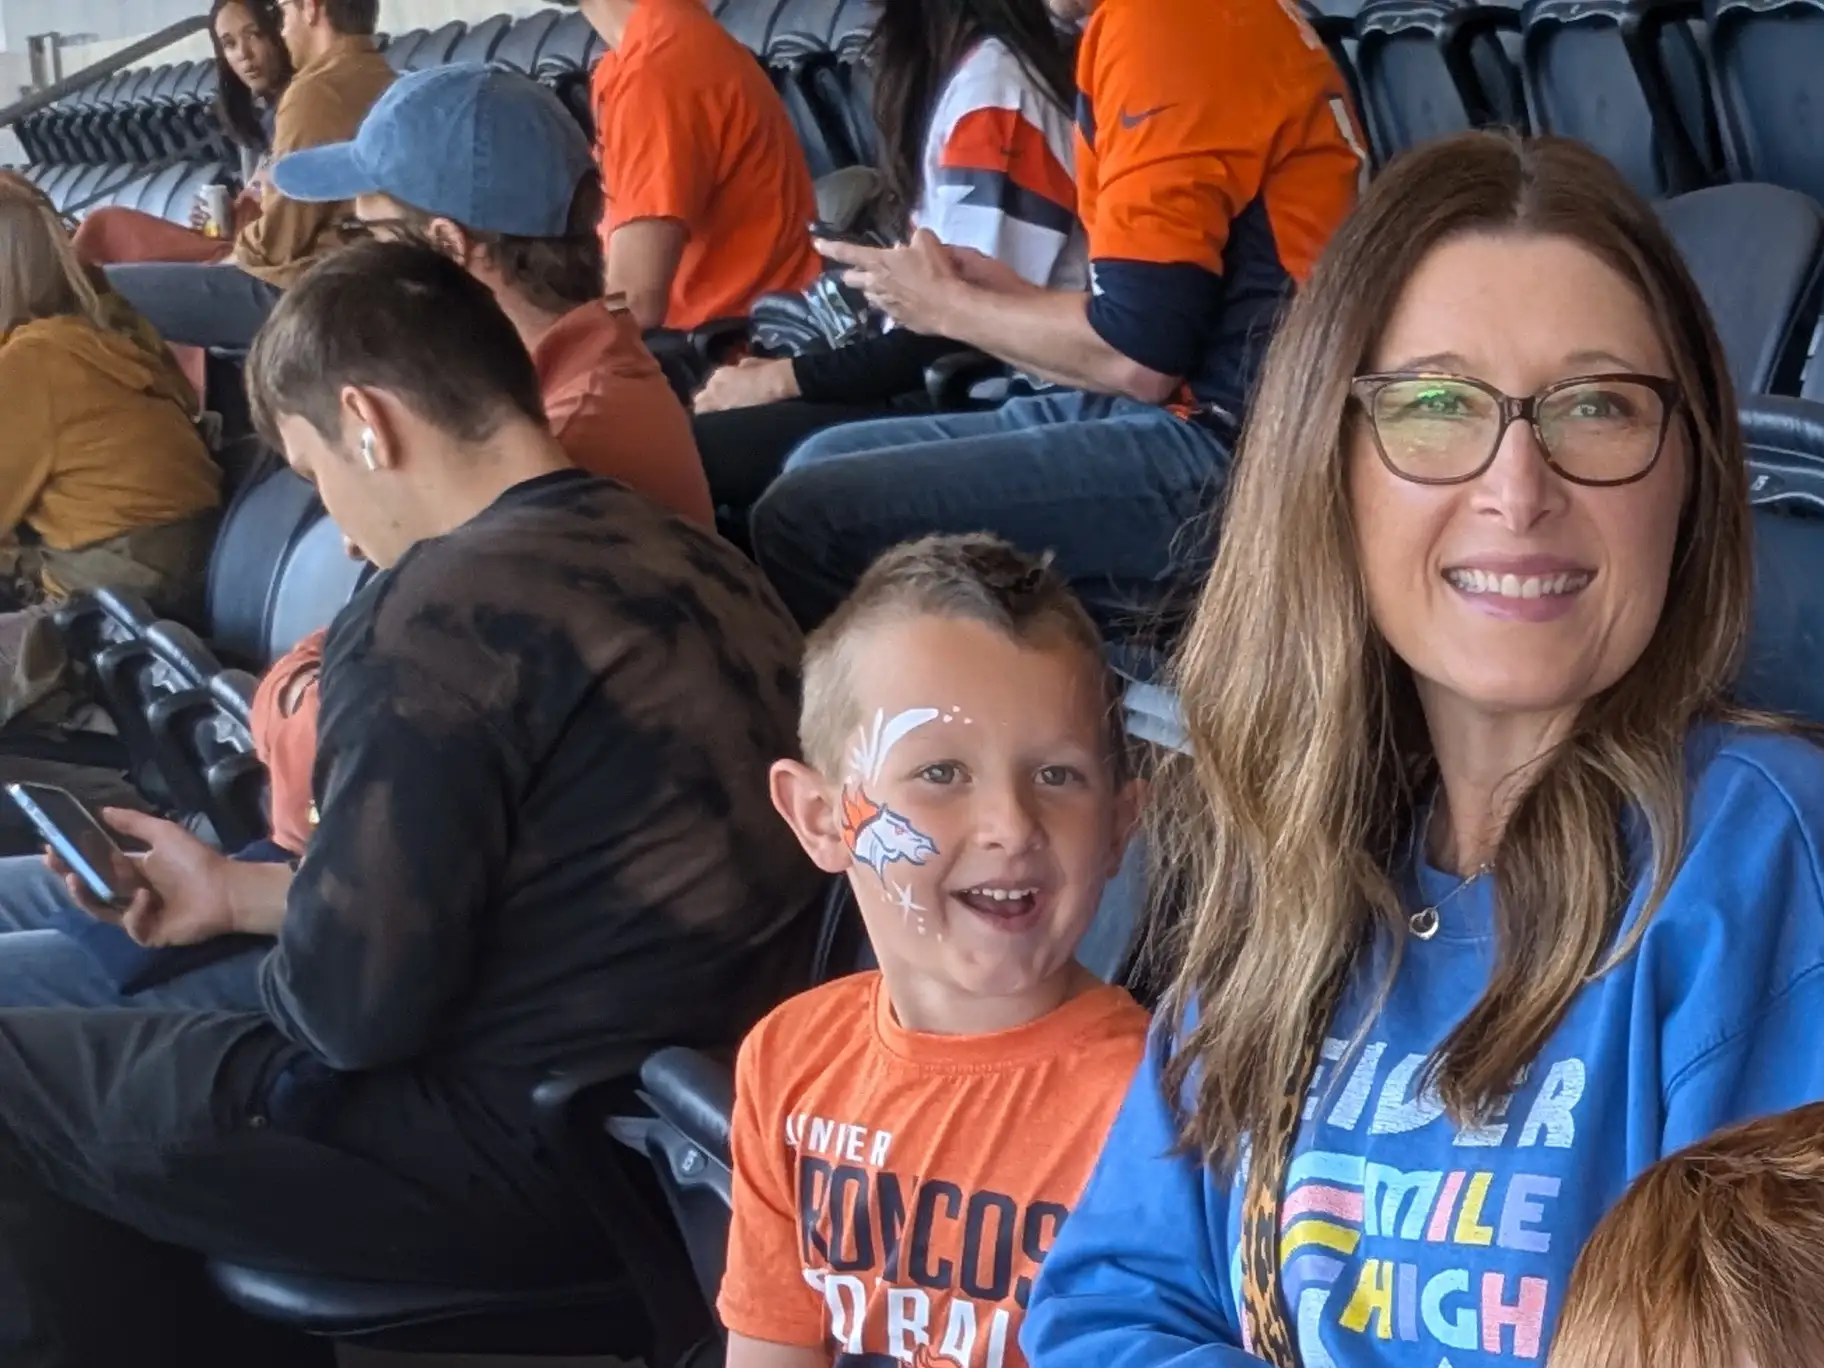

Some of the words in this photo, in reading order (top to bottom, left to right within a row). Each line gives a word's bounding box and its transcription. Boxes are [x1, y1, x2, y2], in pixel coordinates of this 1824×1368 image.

[801, 1155, 1070, 1310] RONCOS
[1364, 1161, 1562, 1253] MILE
[1338, 1258, 1549, 1359] HIGH
